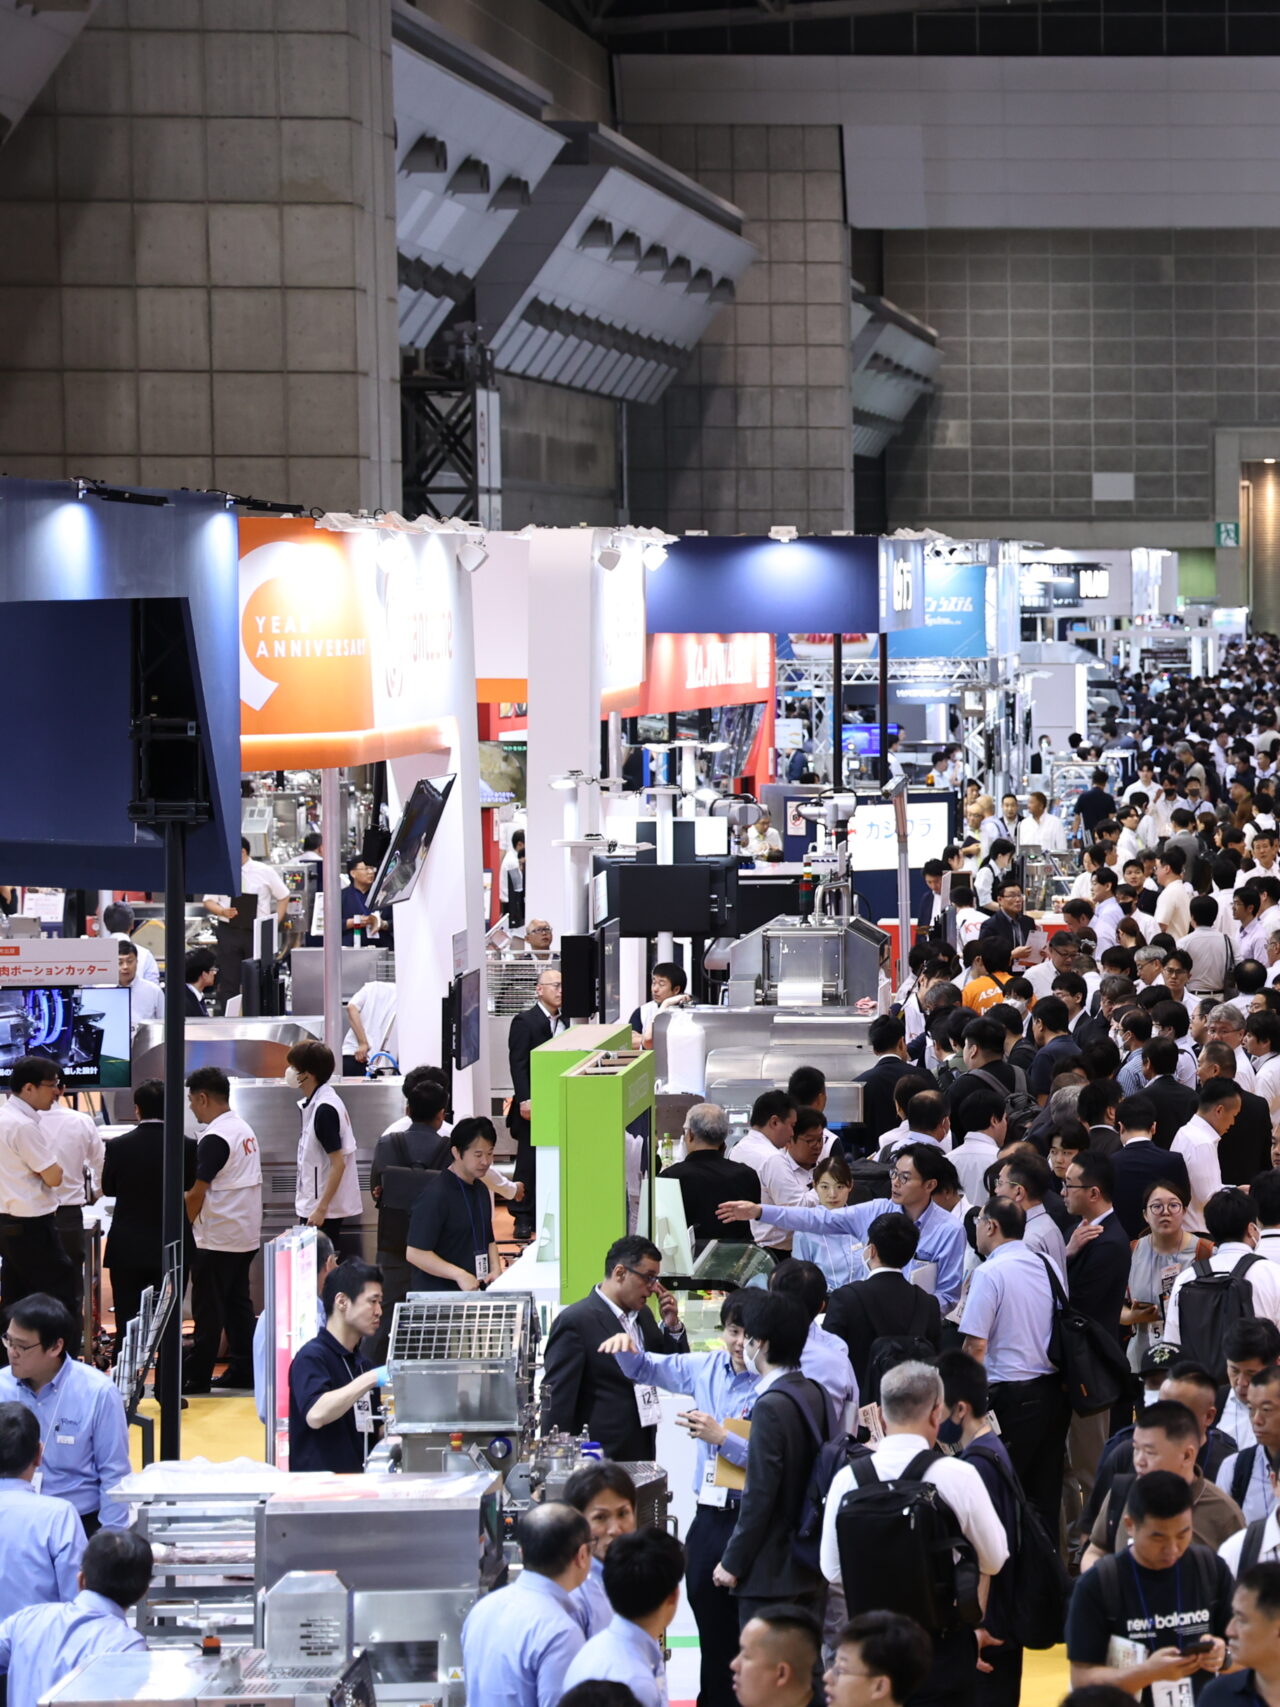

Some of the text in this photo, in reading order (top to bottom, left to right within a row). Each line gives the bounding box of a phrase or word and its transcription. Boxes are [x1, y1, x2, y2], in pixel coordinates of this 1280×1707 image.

[1153, 1327, 1161, 1339] 5
[642, 1391, 652, 1405] 12
[1126, 1617, 1153, 1632] new
[1154, 1608, 1210, 1630] balance
